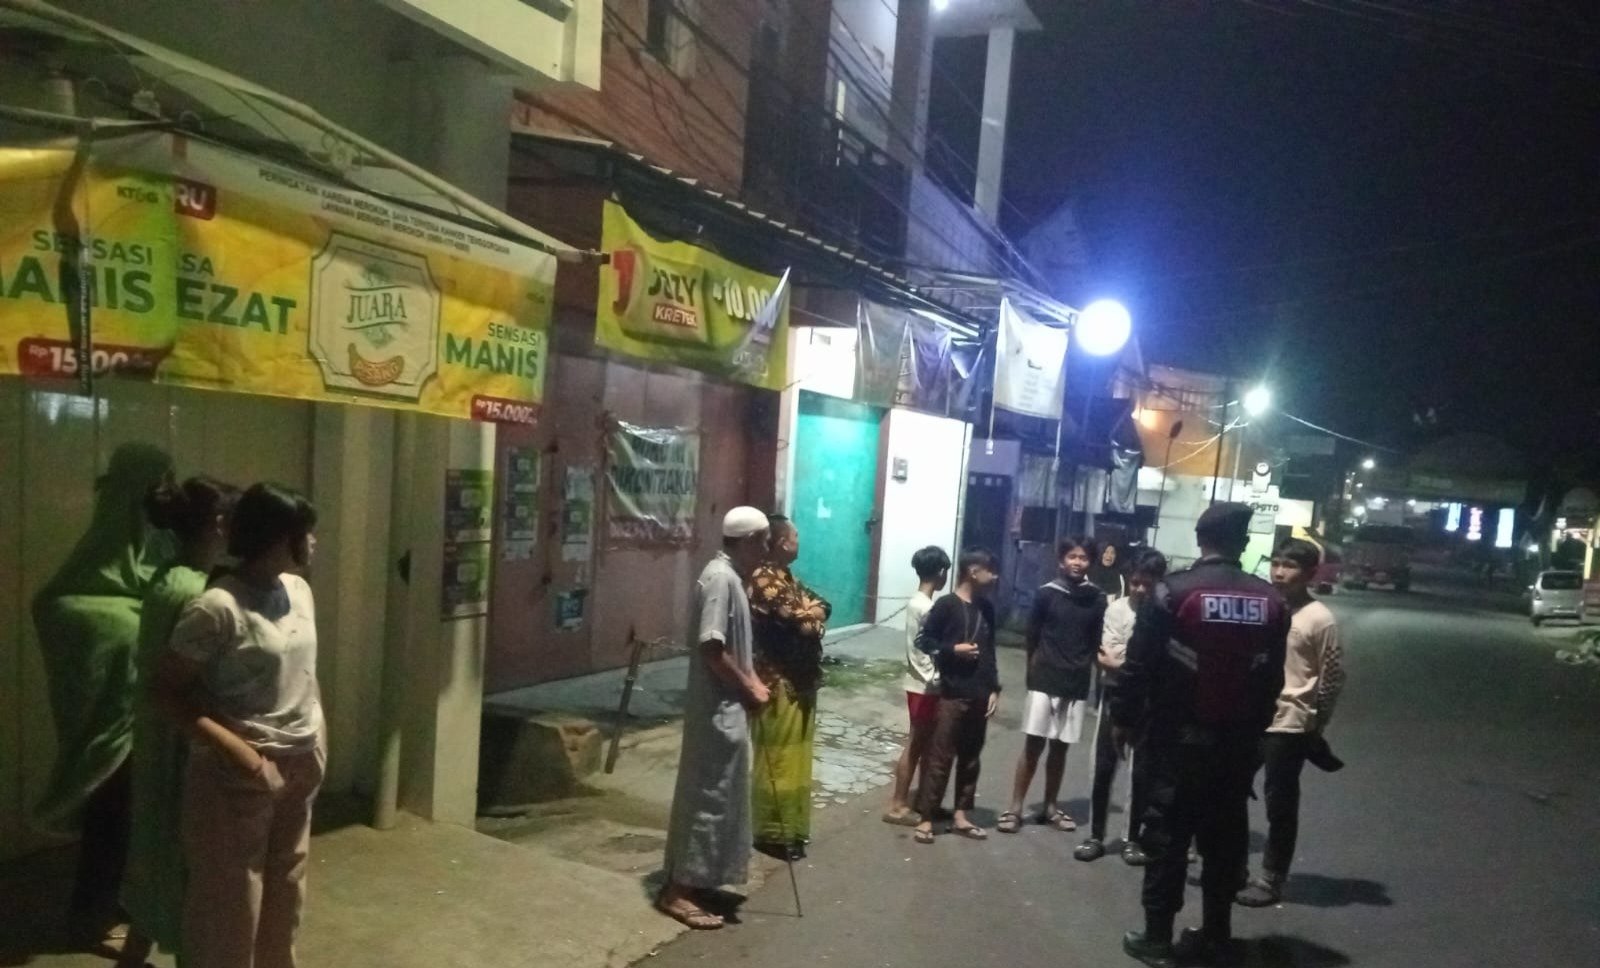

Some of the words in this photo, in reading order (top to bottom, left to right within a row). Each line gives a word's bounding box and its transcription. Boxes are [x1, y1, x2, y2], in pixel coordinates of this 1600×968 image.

[346, 291, 408, 324] JUARA
[655, 305, 698, 326] KRETEK
[487, 322, 542, 347] SENSASI
[446, 333, 539, 379] MANIS
[1204, 596, 1266, 622] POLISI
